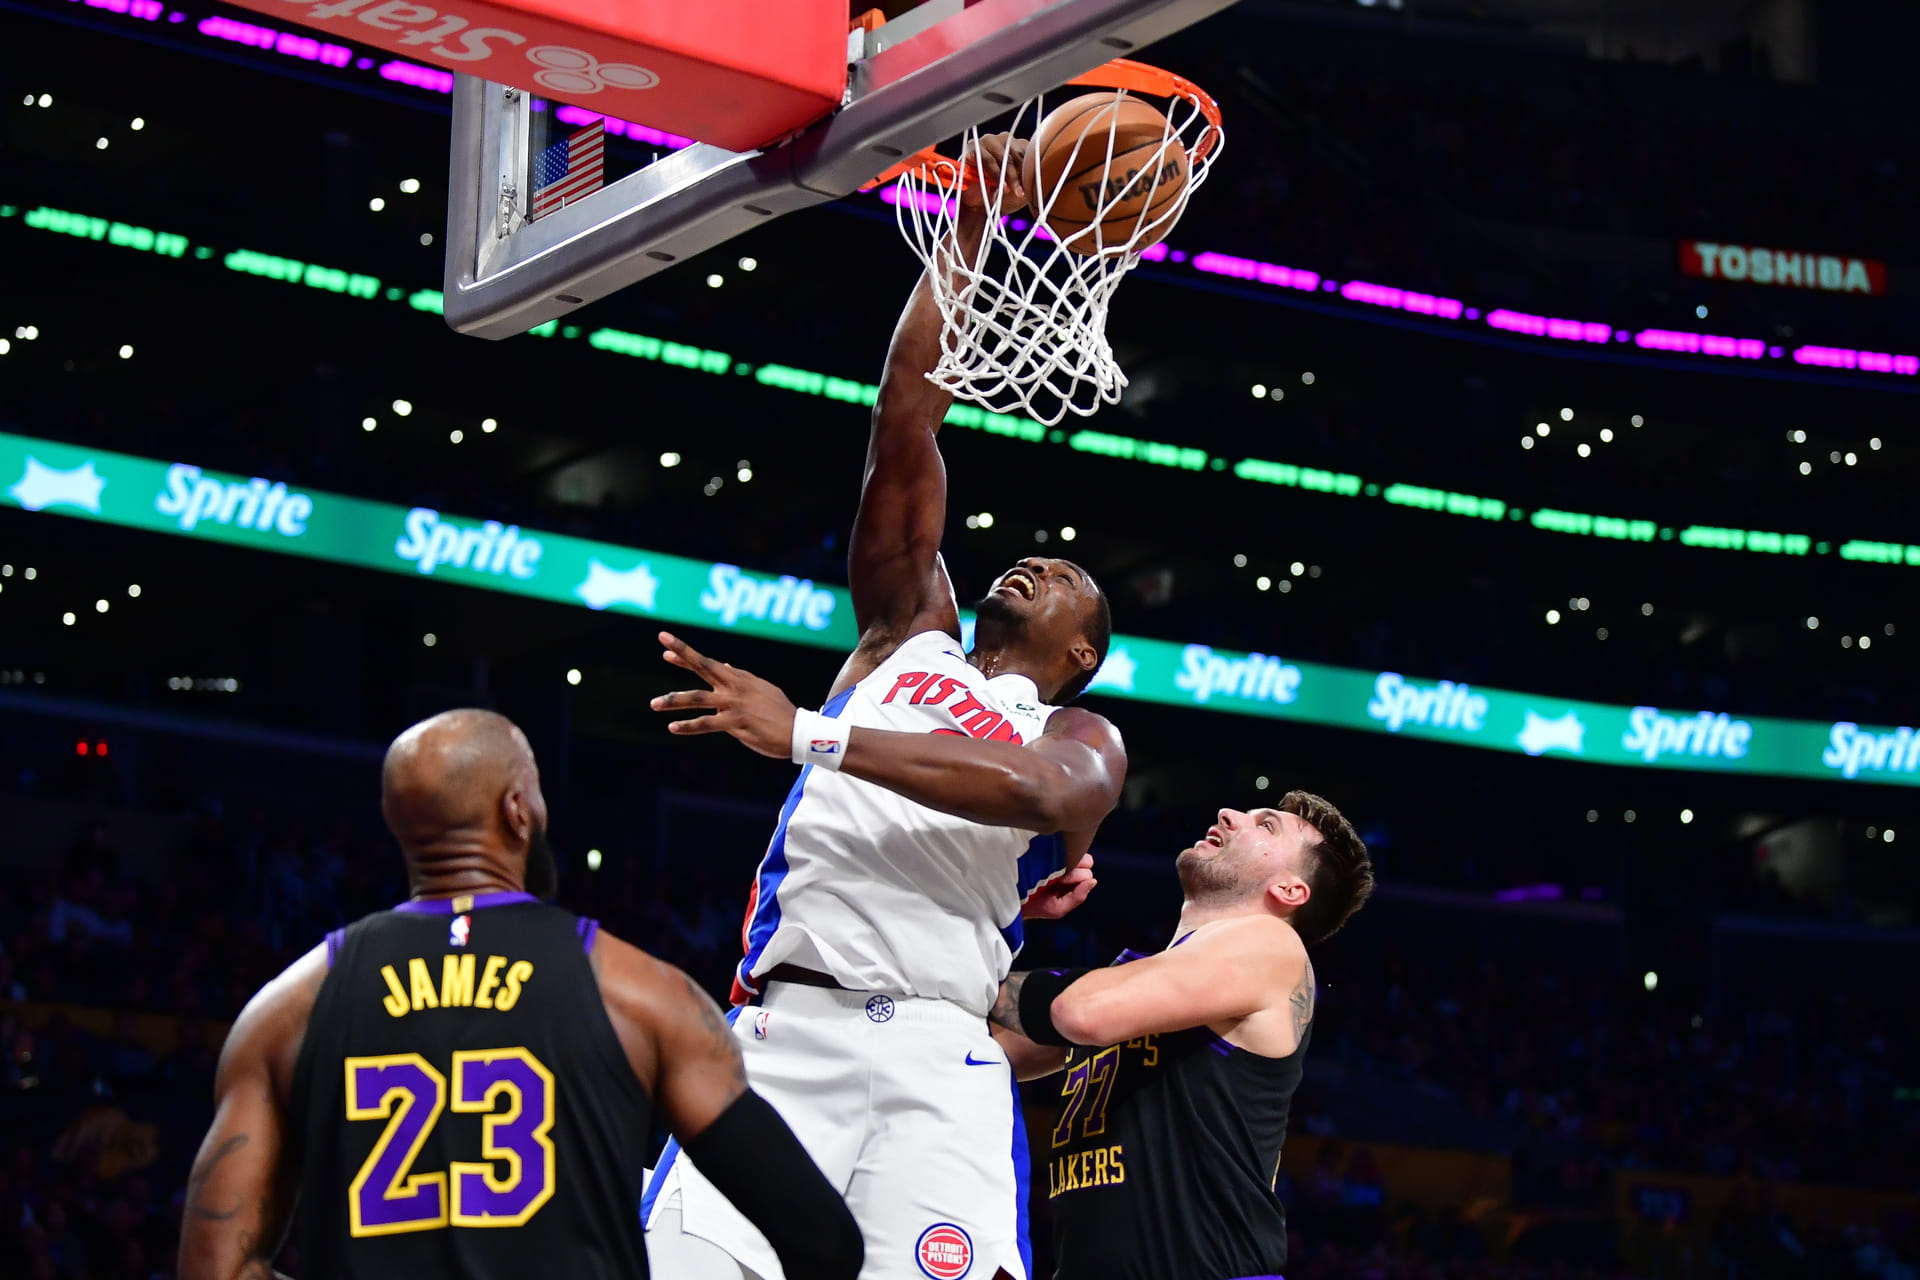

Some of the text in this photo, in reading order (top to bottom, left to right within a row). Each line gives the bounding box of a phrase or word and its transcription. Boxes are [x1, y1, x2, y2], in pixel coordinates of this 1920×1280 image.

[1078, 158, 1180, 212] Wilson
[1694, 242, 1871, 293] TOSHIBA
[155, 464, 313, 537] Sprite
[395, 508, 543, 579] Sprite
[699, 563, 836, 631] Sprite
[1174, 645, 1302, 705] Sprite
[1367, 672, 1489, 732] Sprite
[881, 671, 1024, 746] PISTON
[1622, 706, 1753, 762] Sprite
[1822, 721, 1920, 779] Sprit
[380, 953, 534, 1018] JAMES
[1051, 1043, 1121, 1148] 77
[344, 1046, 556, 1238] 23
[1049, 1145, 1126, 1199] LAKERS
[927, 1241, 964, 1255] DETROIT
[927, 1251, 964, 1266] PISTONS
